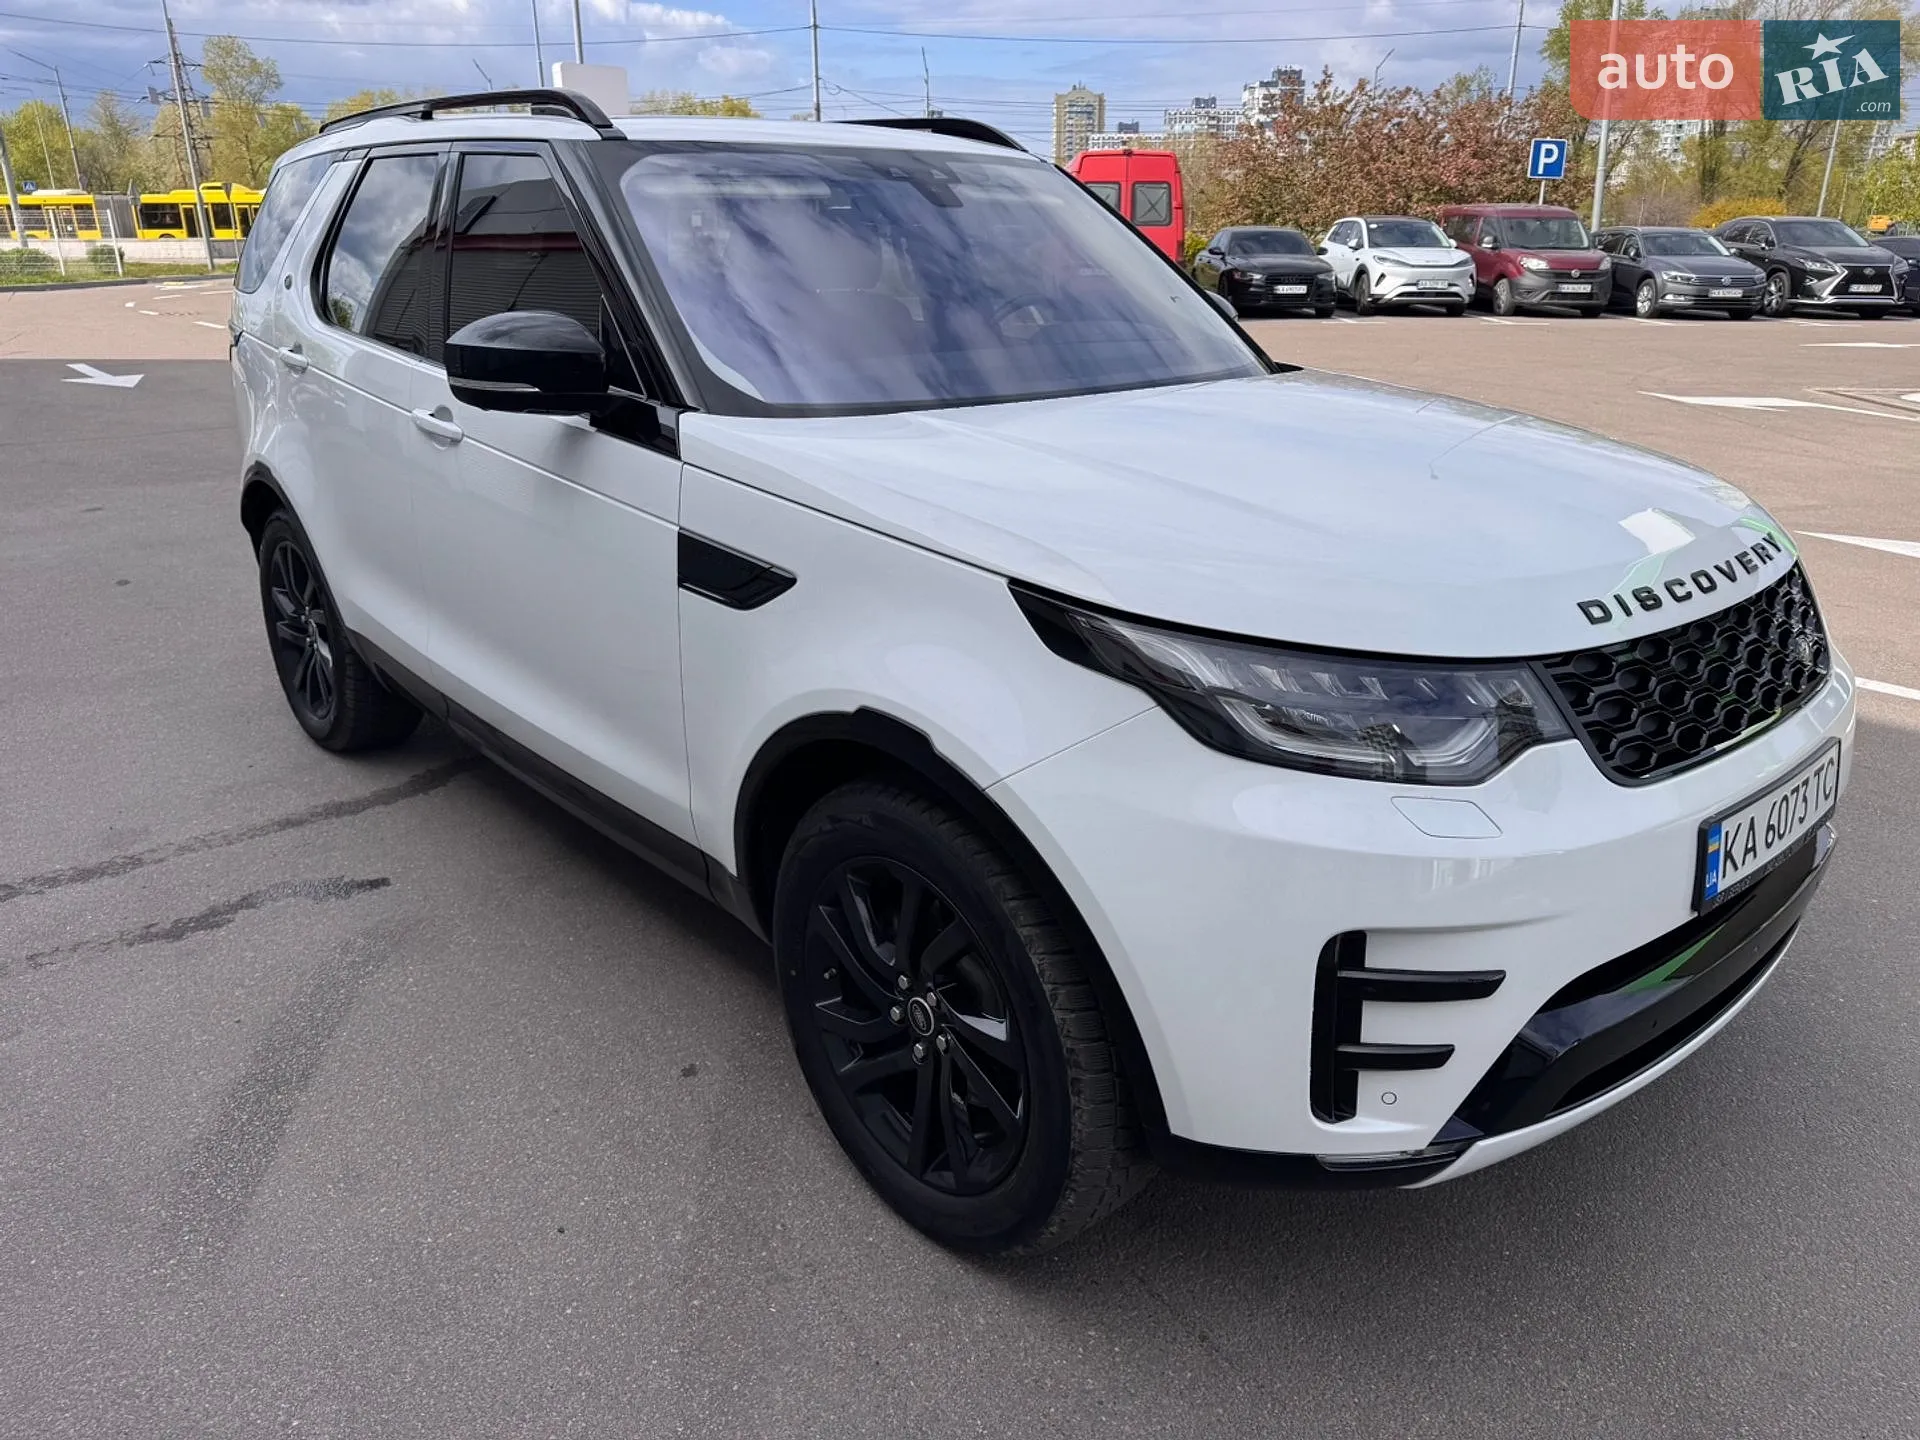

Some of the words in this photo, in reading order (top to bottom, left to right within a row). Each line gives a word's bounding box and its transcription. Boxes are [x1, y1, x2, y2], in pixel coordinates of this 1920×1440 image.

[1537, 143, 1559, 175] P
[1576, 532, 1783, 626] DISCOVERY
[1722, 816, 1757, 879] KA
[1765, 778, 1809, 849] 6073
[1814, 757, 1835, 812] TC
[1705, 869, 1717, 888] UA
